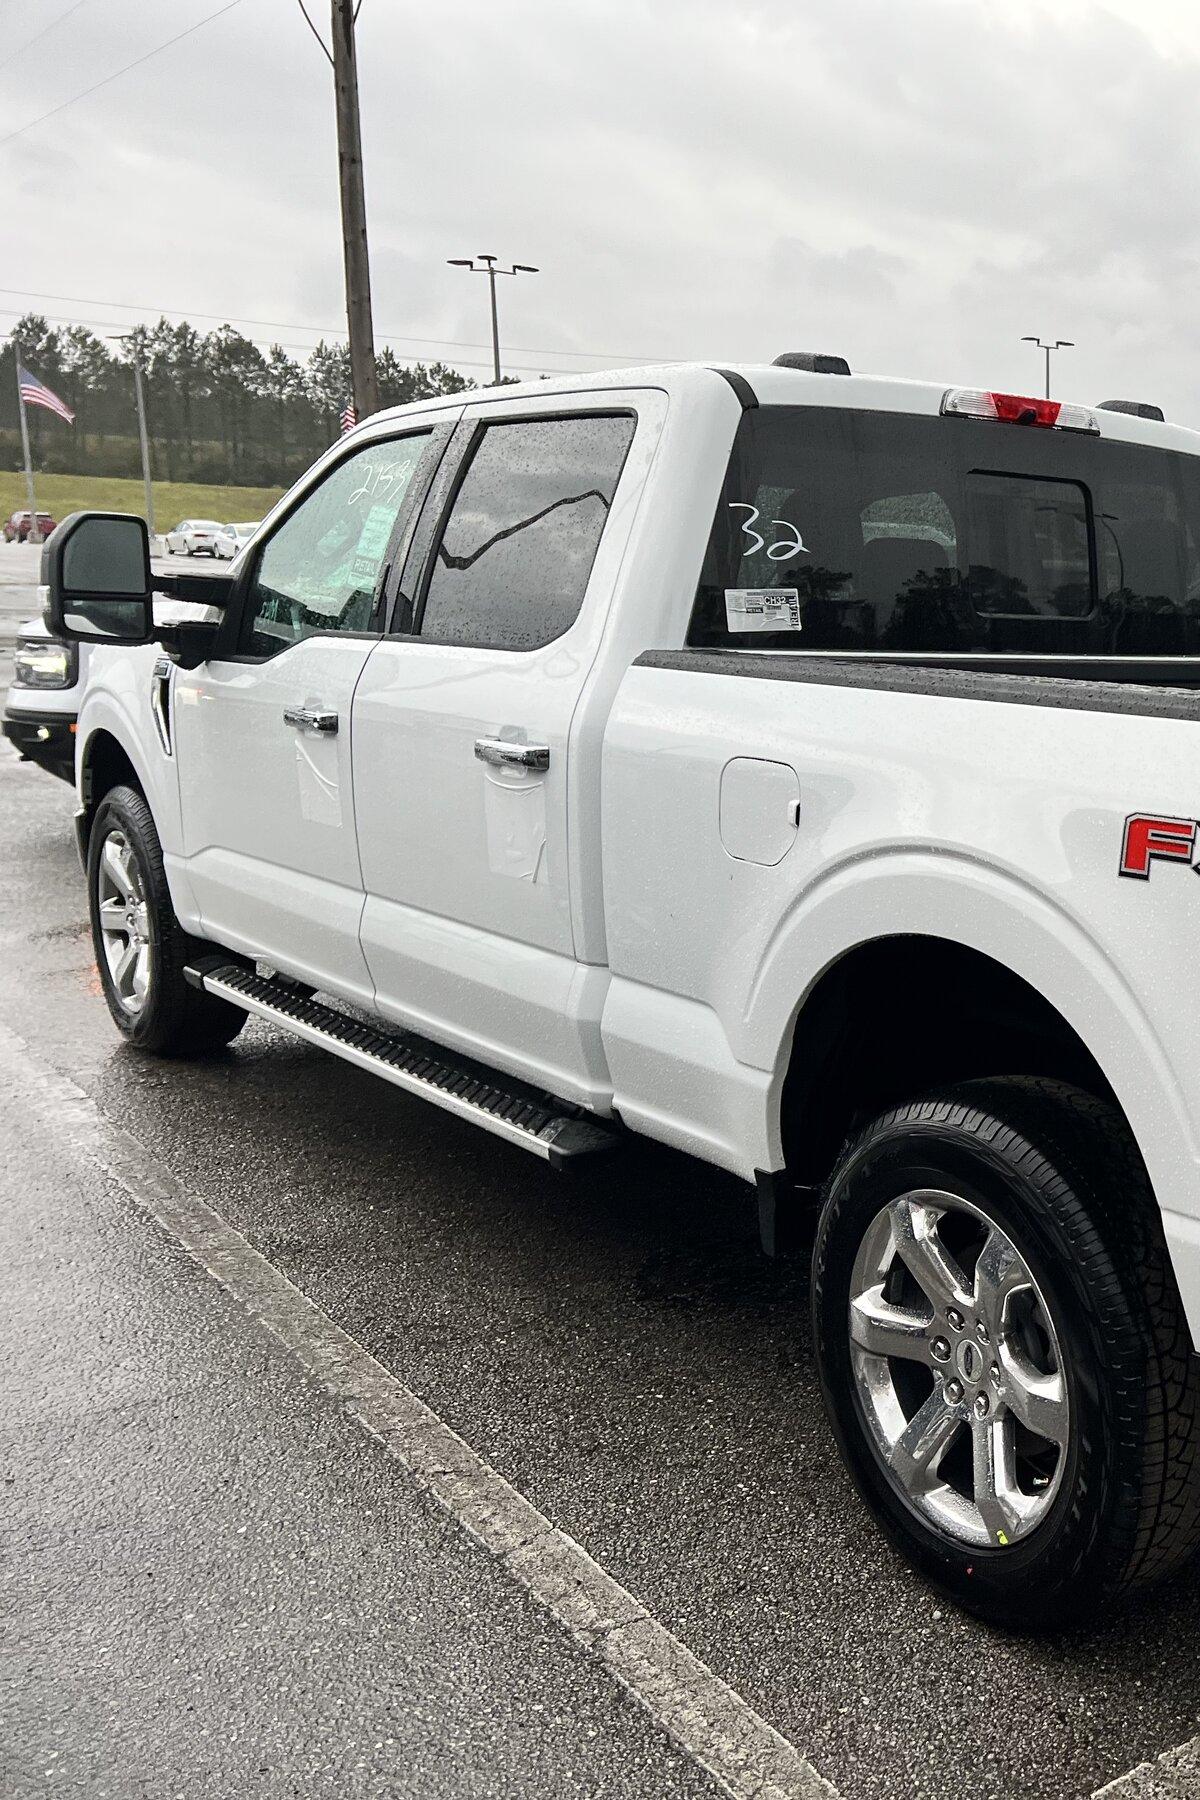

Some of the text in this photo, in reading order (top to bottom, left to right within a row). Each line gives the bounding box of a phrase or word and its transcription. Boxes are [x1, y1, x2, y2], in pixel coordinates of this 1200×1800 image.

[729, 503, 811, 560] 32
[764, 596, 787, 605] CH32
[789, 596, 799, 625] RETAIL
